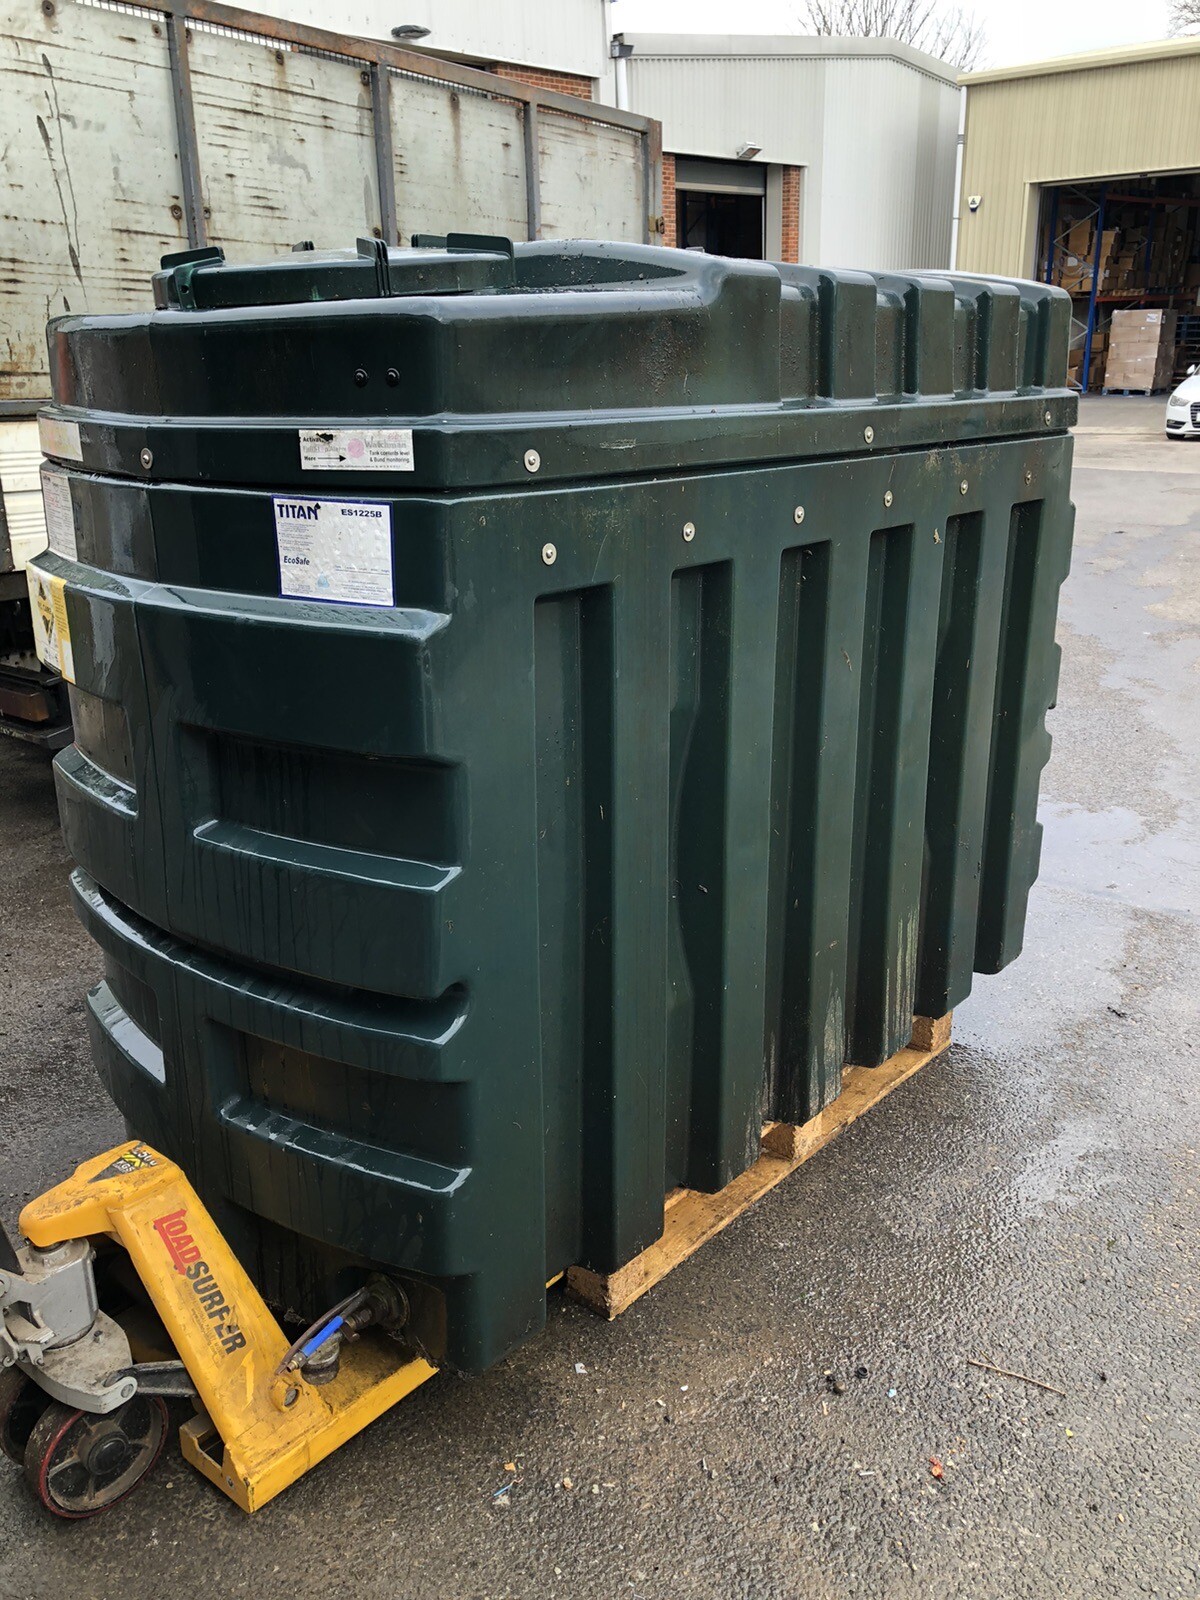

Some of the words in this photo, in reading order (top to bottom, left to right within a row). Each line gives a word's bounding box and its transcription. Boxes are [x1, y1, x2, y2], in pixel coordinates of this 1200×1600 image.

[277, 503, 320, 520] TITAN
[341, 508, 383, 518] ES1225B
[283, 556, 310, 566] EcoSafe
